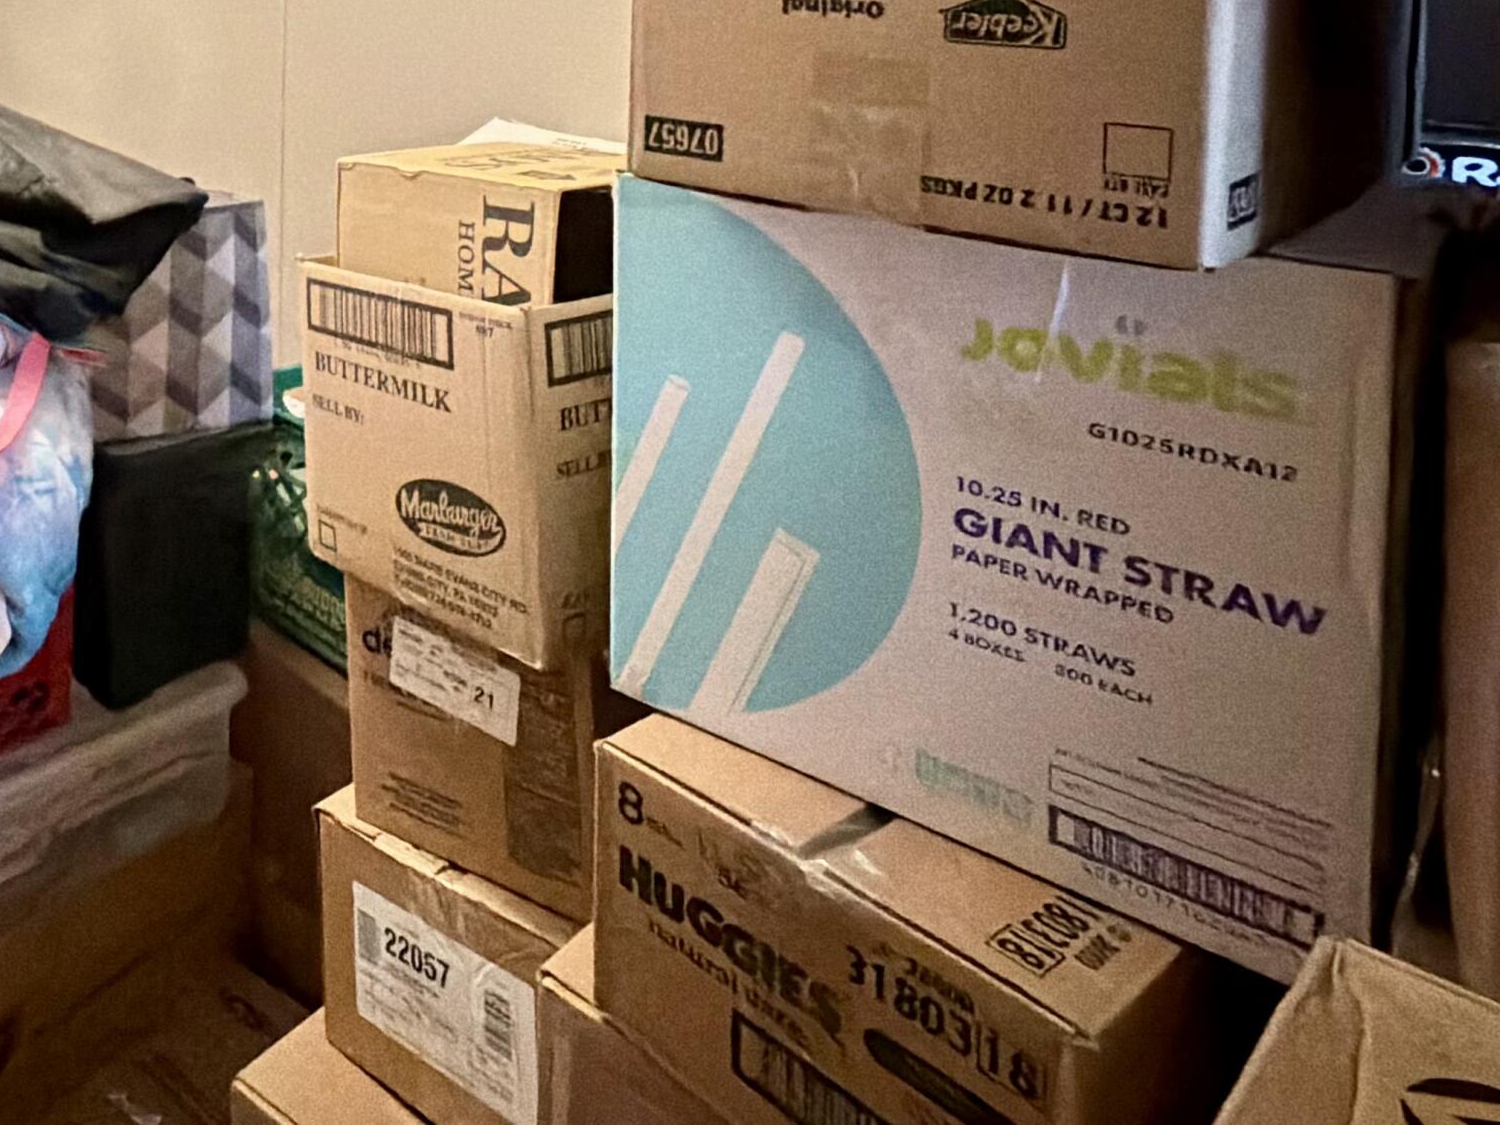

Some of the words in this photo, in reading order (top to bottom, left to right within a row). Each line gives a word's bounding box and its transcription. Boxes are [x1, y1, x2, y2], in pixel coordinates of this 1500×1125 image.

[950, 9, 1064, 48] Keebler
[647, 121, 720, 156] 07657
[920, 174, 978, 201] PKGS
[983, 183, 1014, 205] OZ
[1098, 199, 1129, 223] CT
[1134, 204, 1169, 230] 12
[314, 350, 453, 414] BUTTERMILK
[311, 393, 343, 417] SELL
[399, 487, 503, 544] Marburger
[956, 475, 1023, 508] 10.25
[1031, 496, 1069, 524] IN.
[1077, 508, 1131, 537] RED
[951, 543, 1029, 582] PAPER
[1034, 568, 1176, 625] WRAPPED
[953, 506, 1109, 575] GIANT
[1123, 554, 1329, 637] STRAW
[948, 601, 1018, 638] 1,200
[1024, 626, 1137, 678] STRAWS
[473, 685, 495, 711] 21
[1097, 677, 1155, 707] EACH
[618, 781, 645, 826] 8
[384, 926, 451, 989] 22057
[618, 843, 843, 1037] HUGGIES
